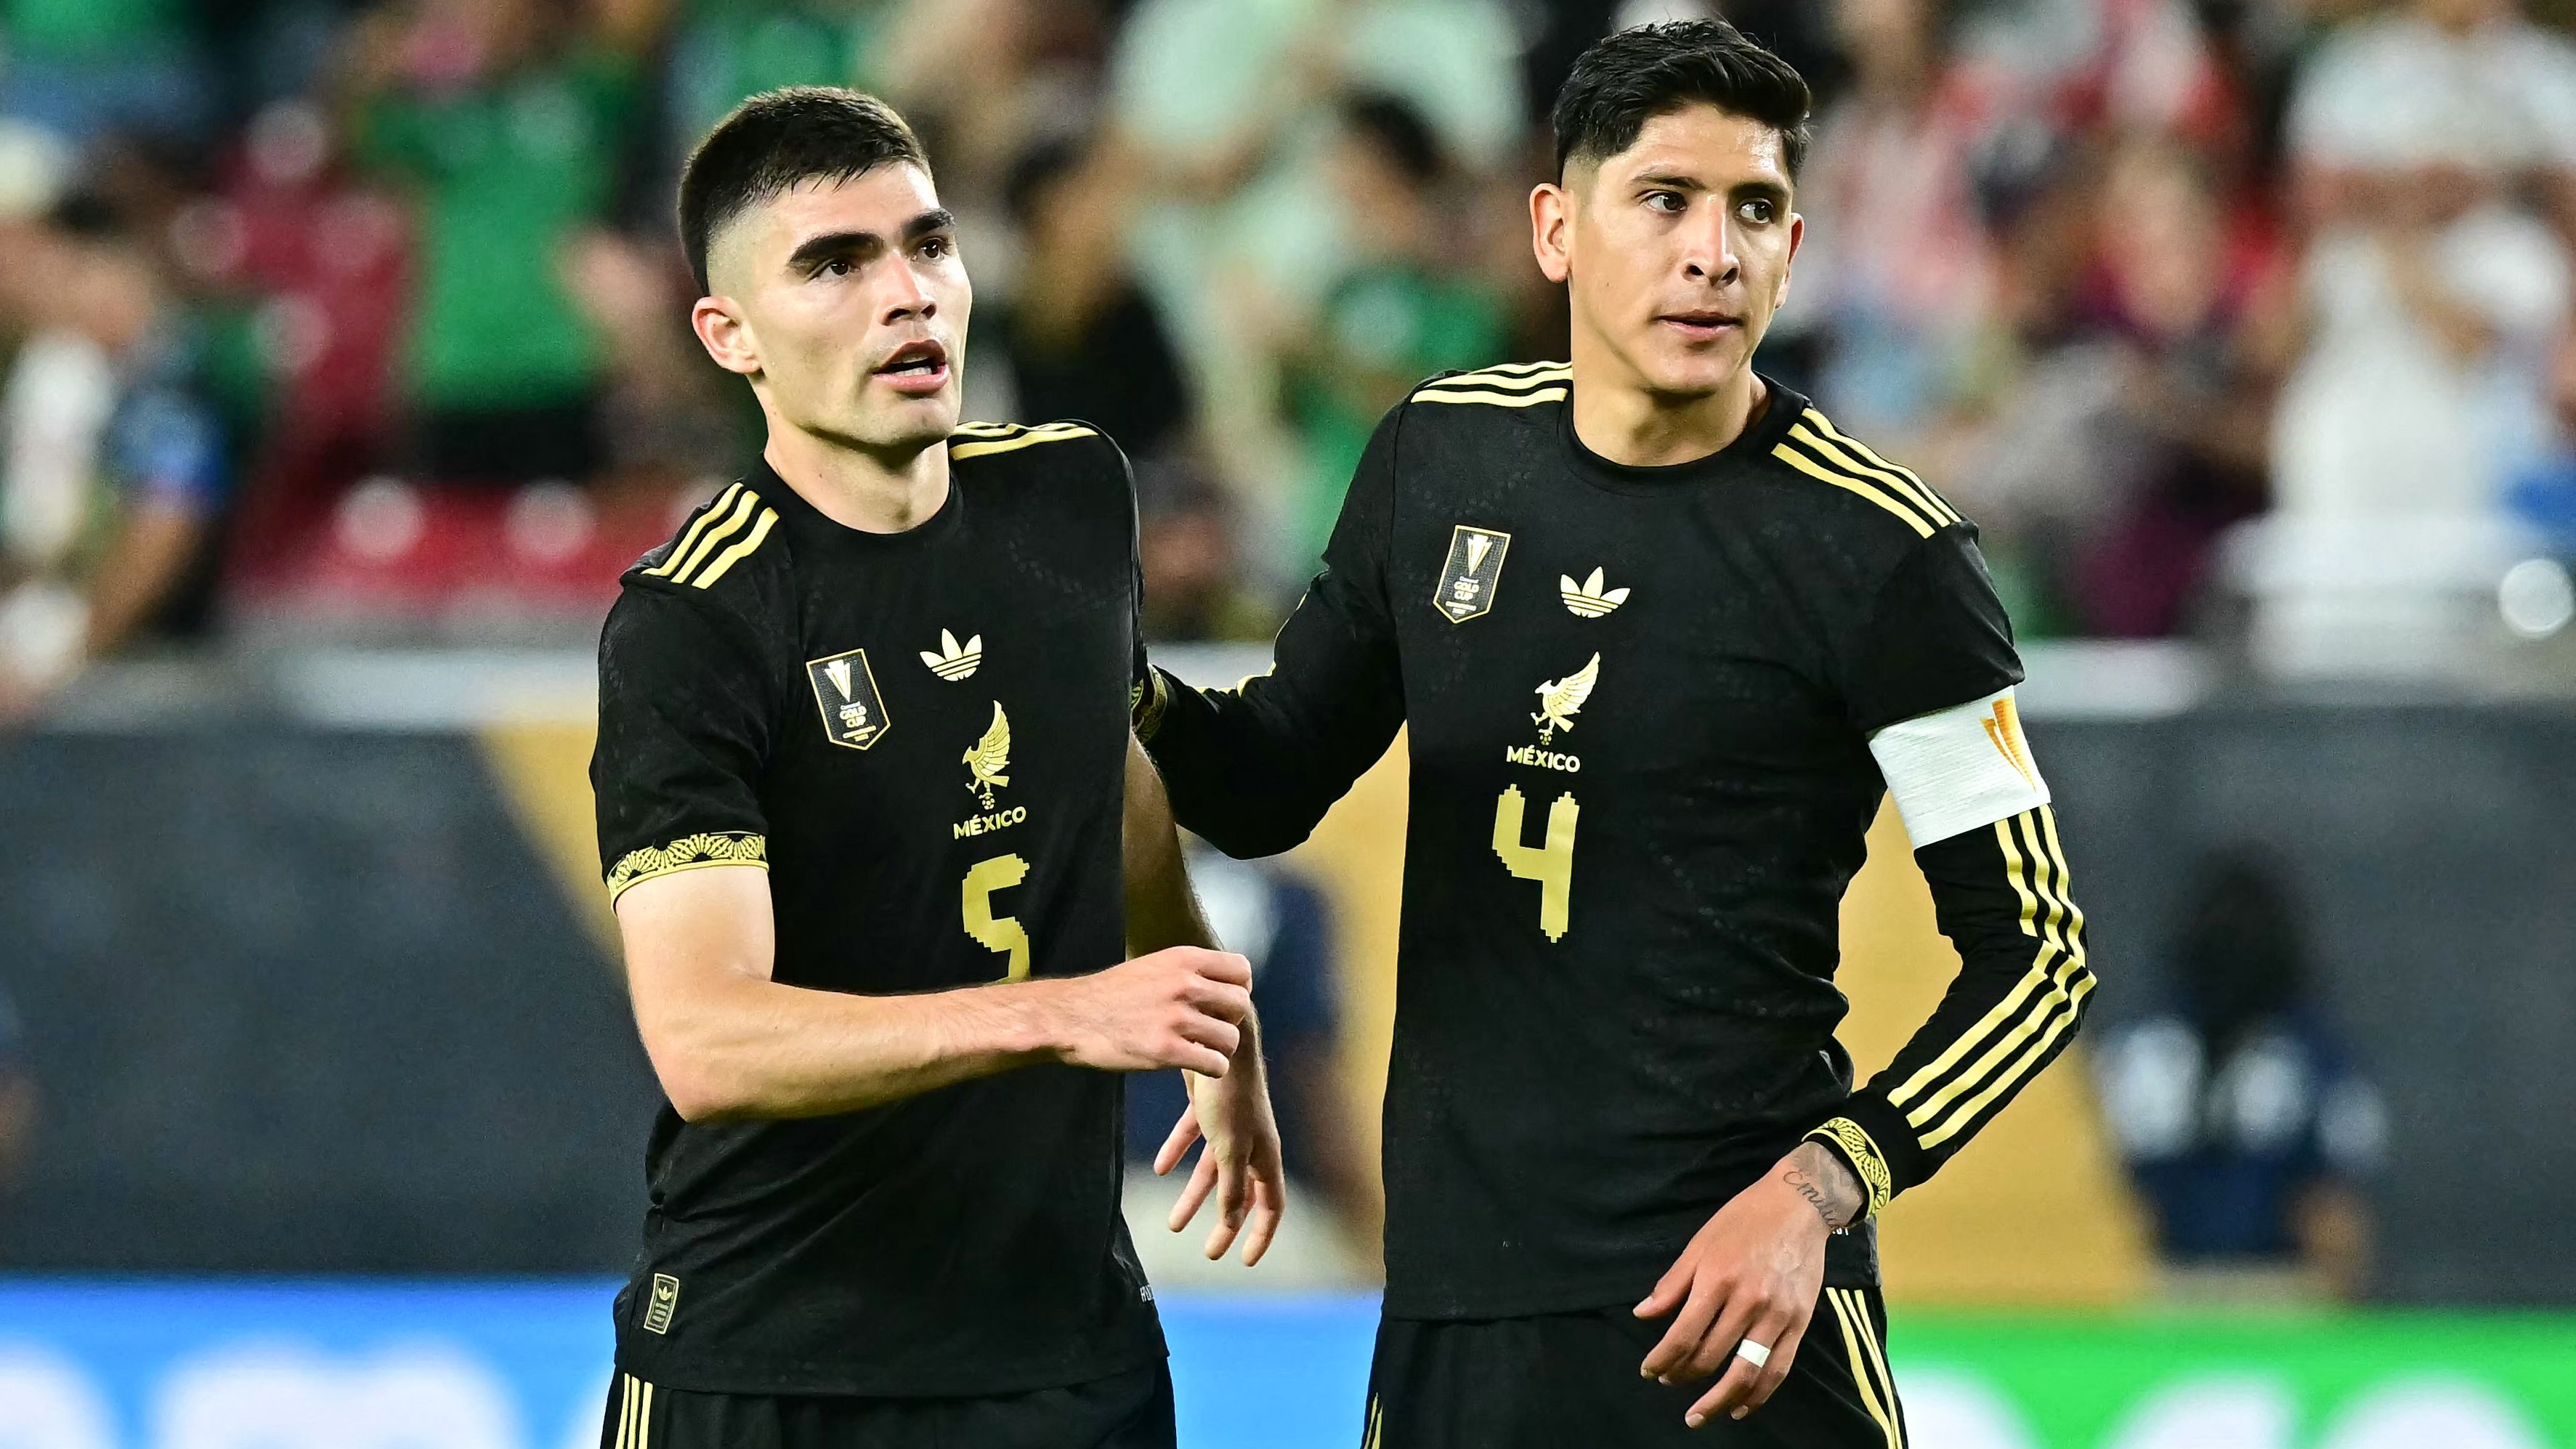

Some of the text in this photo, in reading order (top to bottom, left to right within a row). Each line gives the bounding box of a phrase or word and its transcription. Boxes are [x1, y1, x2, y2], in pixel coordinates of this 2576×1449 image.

[1454, 581, 1480, 593] GOLD
[1454, 590, 1474, 601] CUP
[839, 705, 867, 721] GOLD
[846, 715, 867, 728] CUP
[1506, 744, 1581, 773] MÉXICO
[952, 805, 1026, 840] MÉXICO
[1492, 784, 1580, 943] 4
[962, 853, 1031, 985] 5
